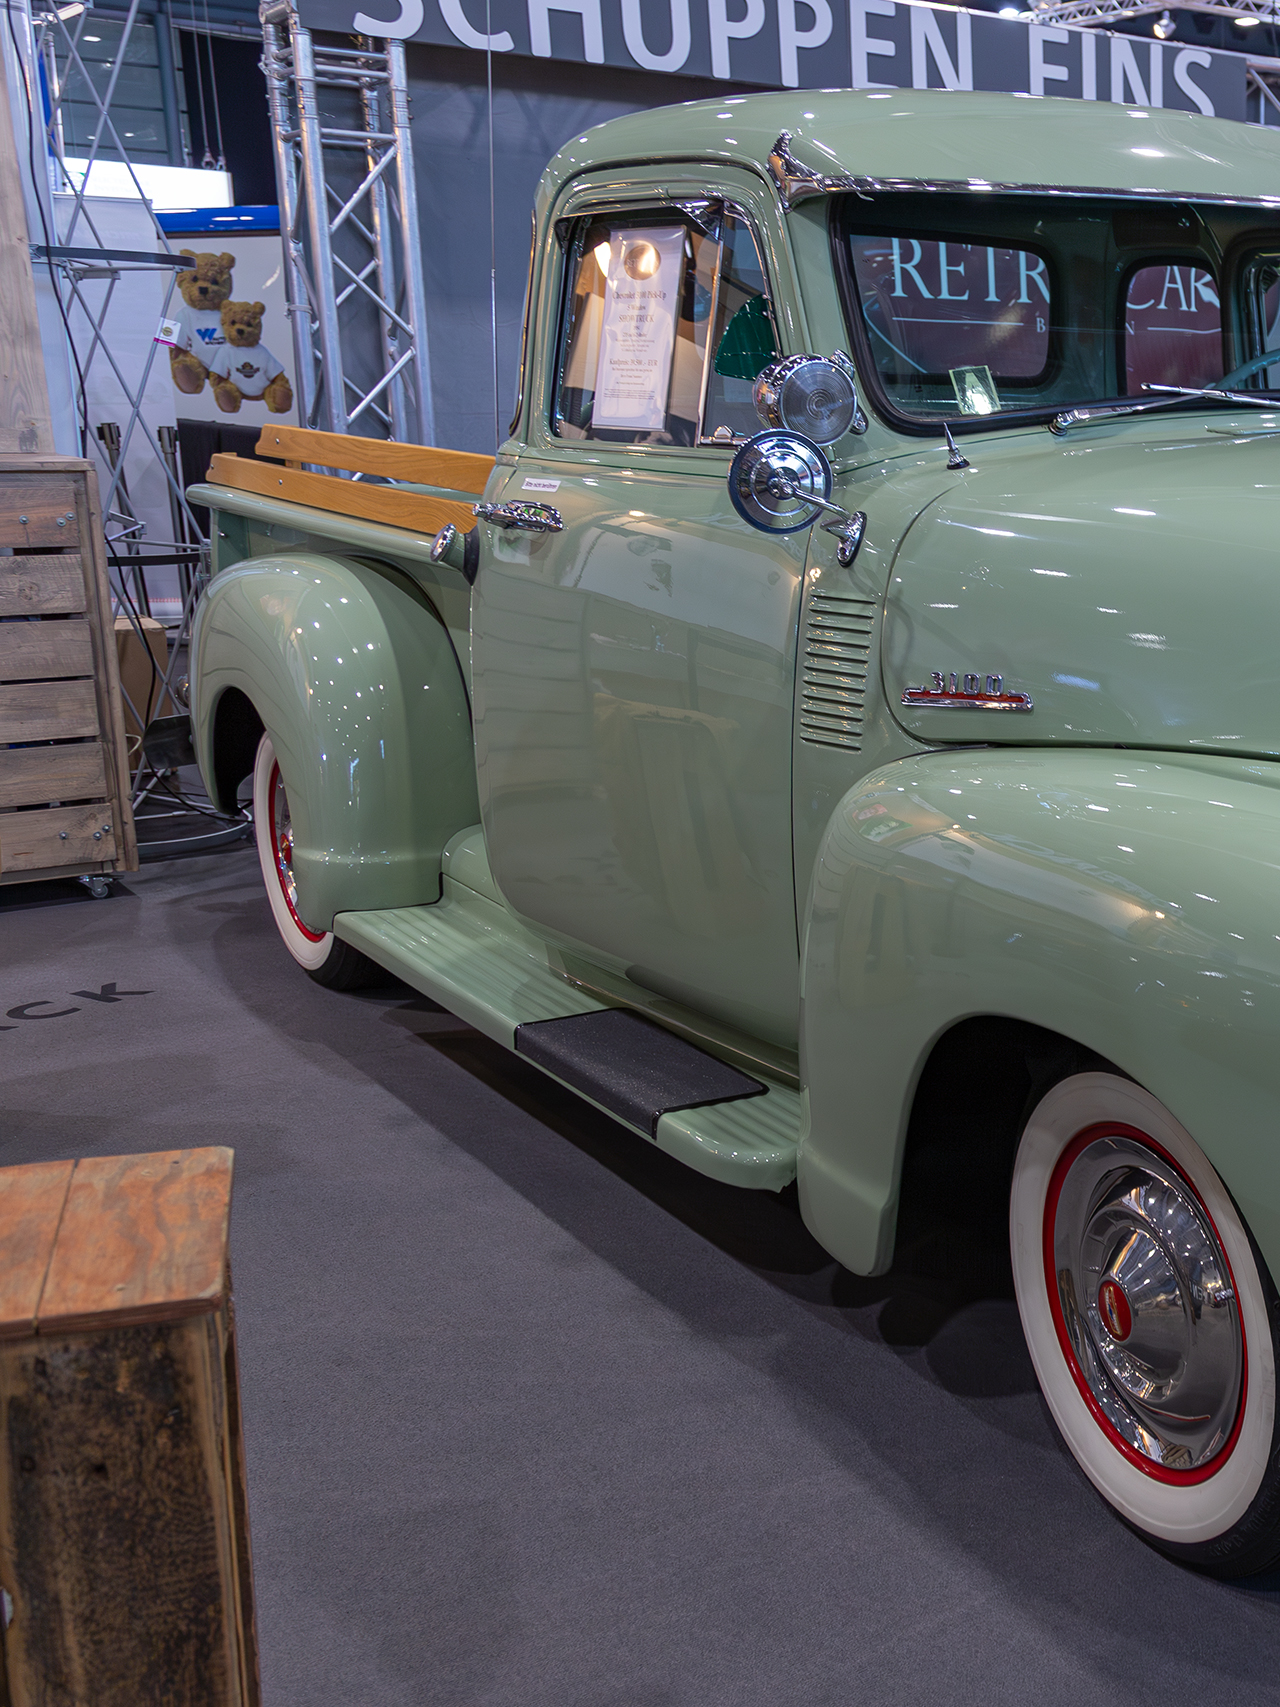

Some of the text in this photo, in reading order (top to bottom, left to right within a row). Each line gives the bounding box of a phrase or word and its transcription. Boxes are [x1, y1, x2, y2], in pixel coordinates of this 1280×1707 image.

[890, 237, 1050, 304] RETR
[929, 671, 1004, 697] 3100
[0, 982, 156, 1031] CK
